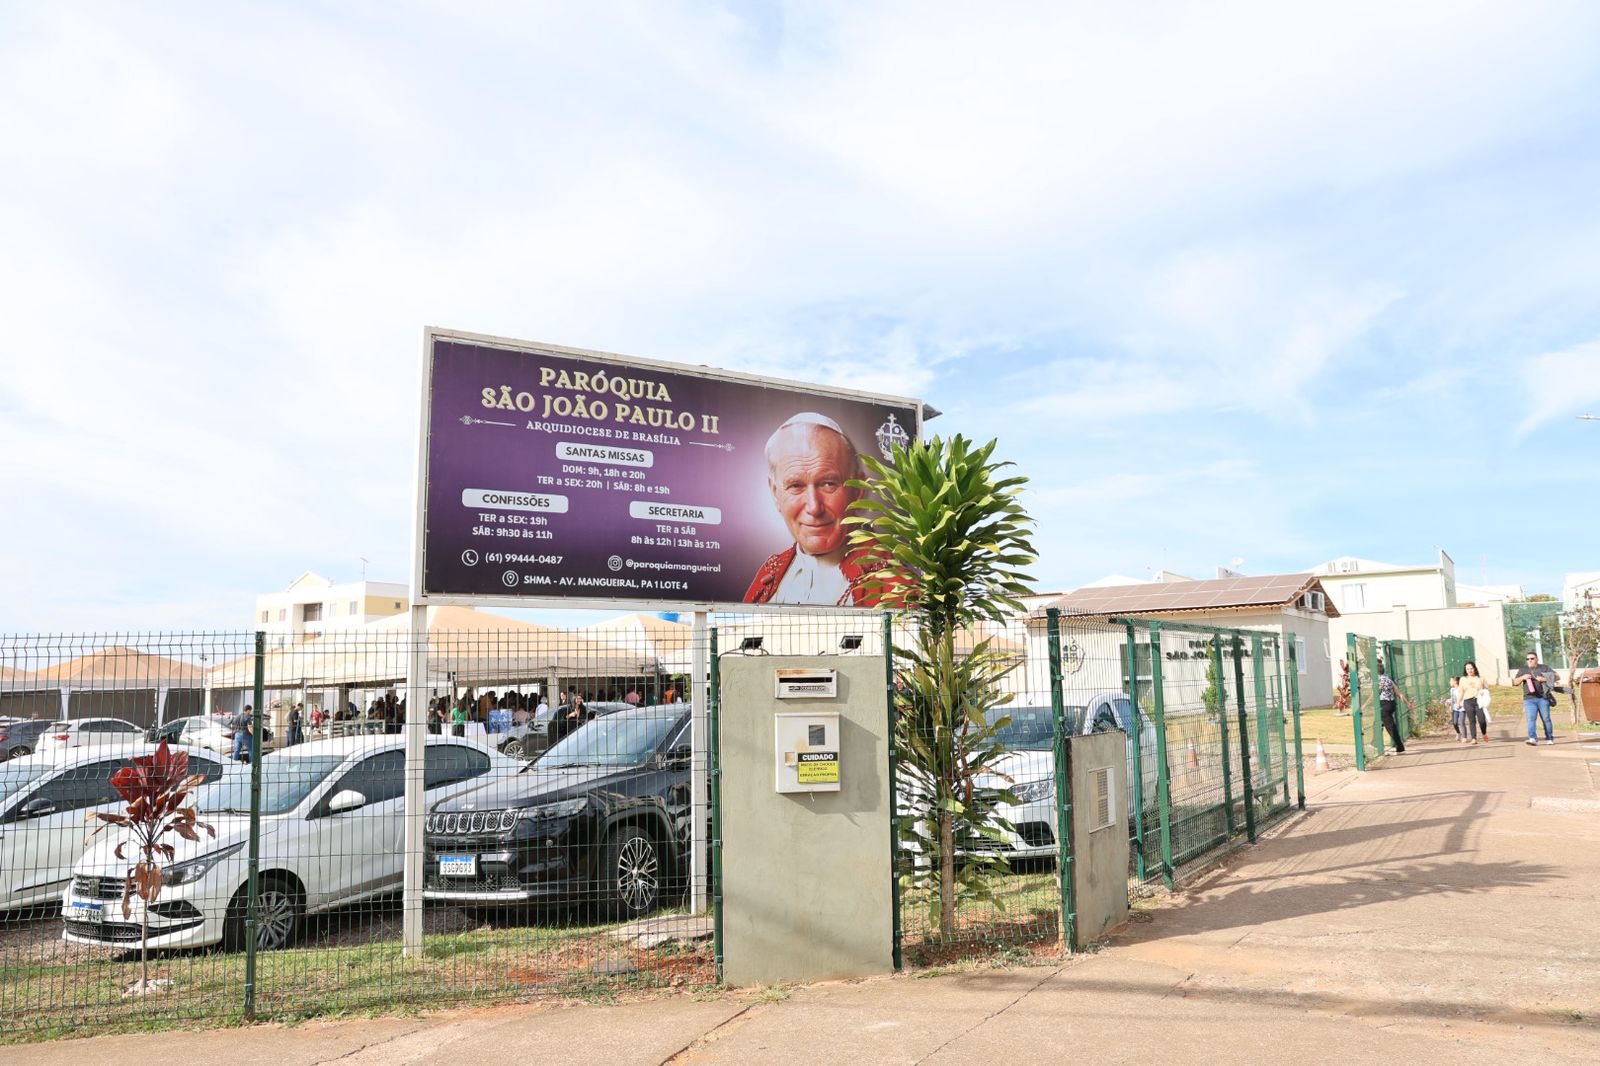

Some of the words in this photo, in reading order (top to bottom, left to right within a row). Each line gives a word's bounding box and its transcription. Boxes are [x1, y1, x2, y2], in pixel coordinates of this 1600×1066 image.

[539, 367, 672, 402] PARÓQUIA
[481, 385, 535, 412] SÃO
[542, 394, 609, 420] JOÃO
[615, 403, 696, 431] PAULO
[701, 414, 720, 434] II
[526, 420, 612, 438] ARQUIDIOCESE
[615, 430, 630, 440] DE
[632, 431, 681, 445] BRASÍLIA
[565, 446, 606, 459] SANTAS
[608, 451, 645, 463] MISSAS
[562, 465, 586, 475] DOM:
[588, 467, 602, 477] 9h,
[604, 469, 620, 478] 18h
[629, 471, 646, 480] 20h
[537, 476, 554, 485] TER
[564, 478, 584, 488] SEX:
[586, 480, 603, 488] 20h
[613, 481, 633, 492] SÁB:
[634, 484, 645, 493] 8h
[654, 486, 670, 495] 19h
[482, 494, 550, 507] CONFISSÕES
[478, 513, 497, 522] TER
[507, 515, 528, 524] SEX:
[530, 516, 548, 525] 19h
[648, 506, 704, 519] SECRETARIA
[472, 525, 494, 536] SÁB:
[496, 528, 520, 538] 9h30
[522, 529, 534, 538] às
[535, 530, 553, 539] 11h
[656, 525, 672, 534] TER
[681, 525, 696, 535] SÁB
[631, 536, 642, 544] 8h
[643, 536, 655, 545] às
[656, 537, 672, 546] 12h
[678, 539, 693, 548] 13h
[694, 540, 705, 548] às
[706, 541, 720, 549] 17h
[485, 553, 503, 564] (61)
[505, 554, 563, 565] 99444-0487
[625, 558, 721, 573] @paroquiamangueiral
[524, 575, 551, 585] SHMA
[559, 577, 576, 586] AV.
[578, 578, 640, 589] MANGUEIRAL,
[641, 580, 653, 588] PA
[660, 581, 681, 589] LOTE
